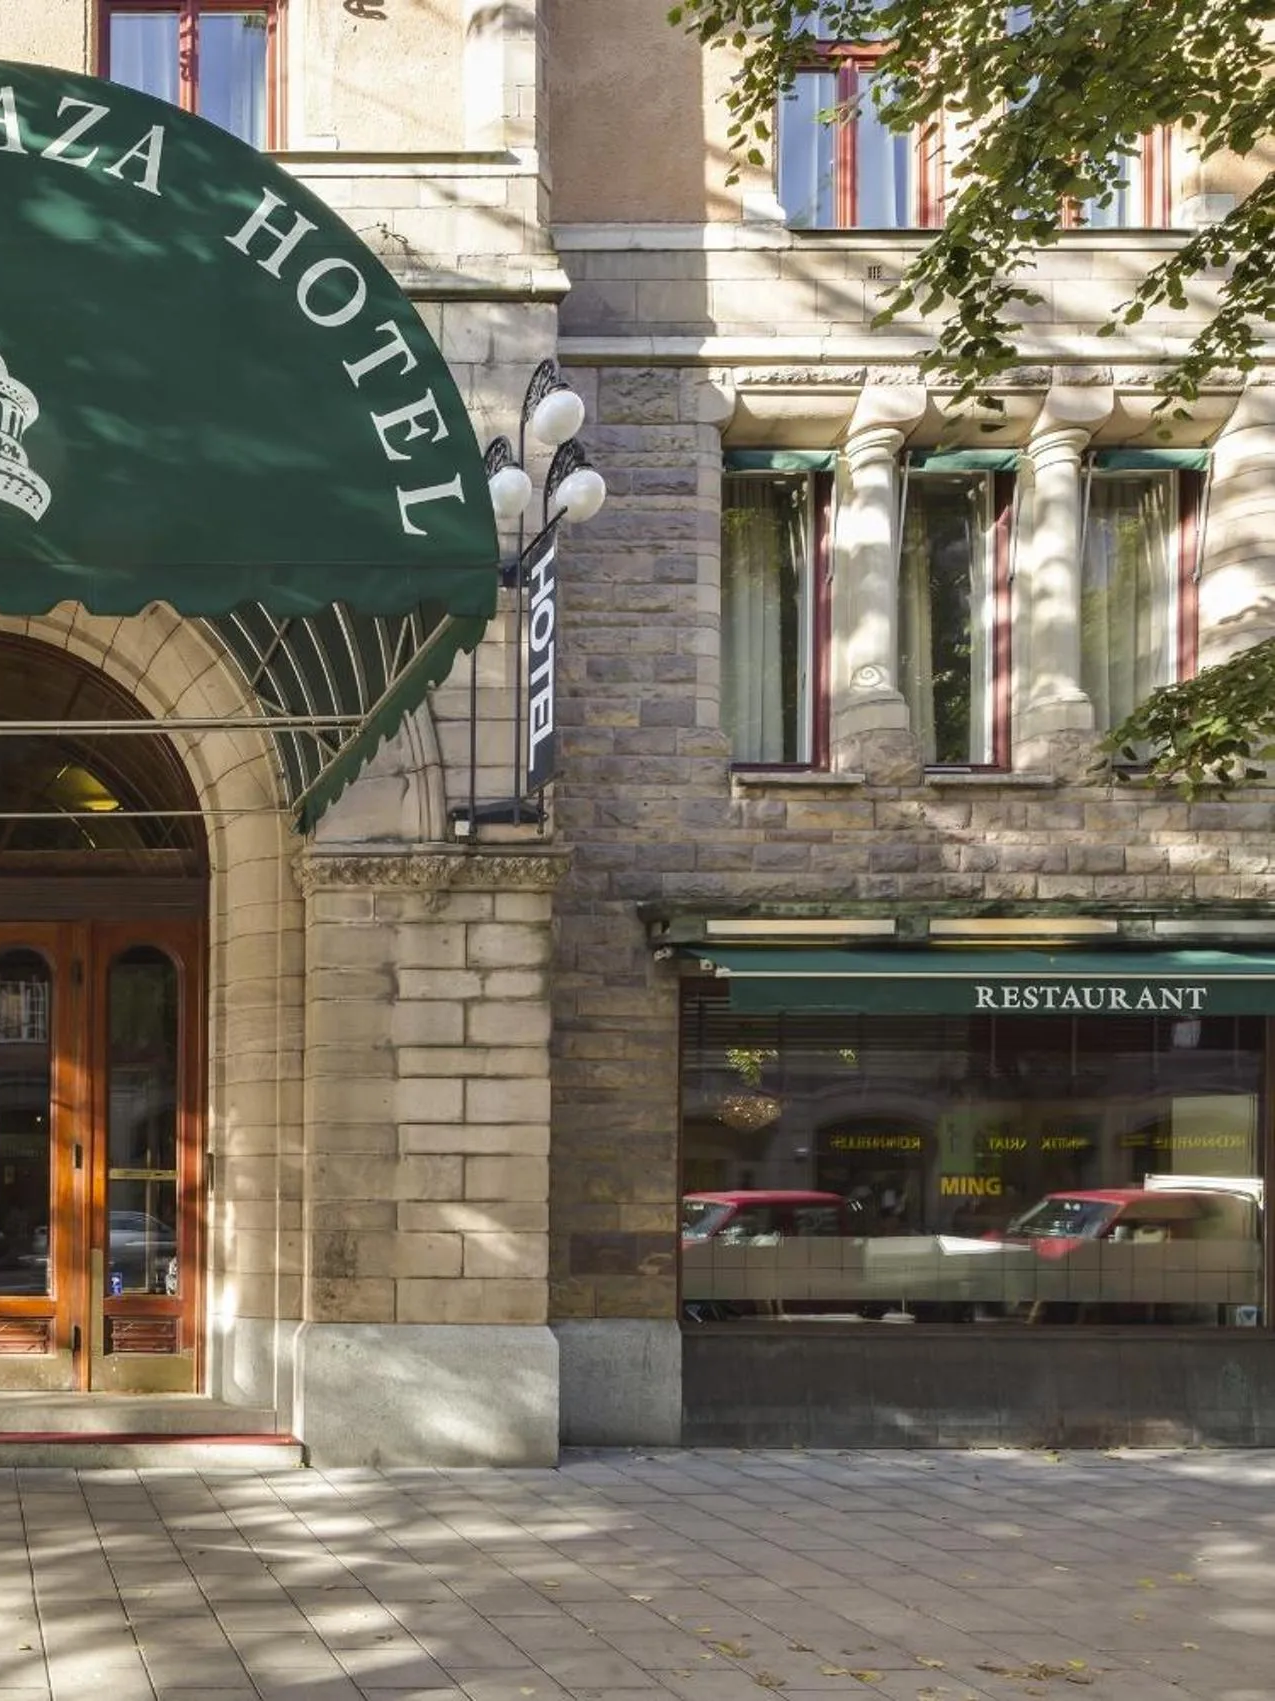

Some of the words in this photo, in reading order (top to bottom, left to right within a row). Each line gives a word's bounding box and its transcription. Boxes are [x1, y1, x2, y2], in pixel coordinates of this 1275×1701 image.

[224, 186, 466, 536] HOTEL
[530, 546, 555, 771] HOTEL
[975, 986, 1207, 1010] RESTAURANT
[940, 1176, 1003, 1197] MING
